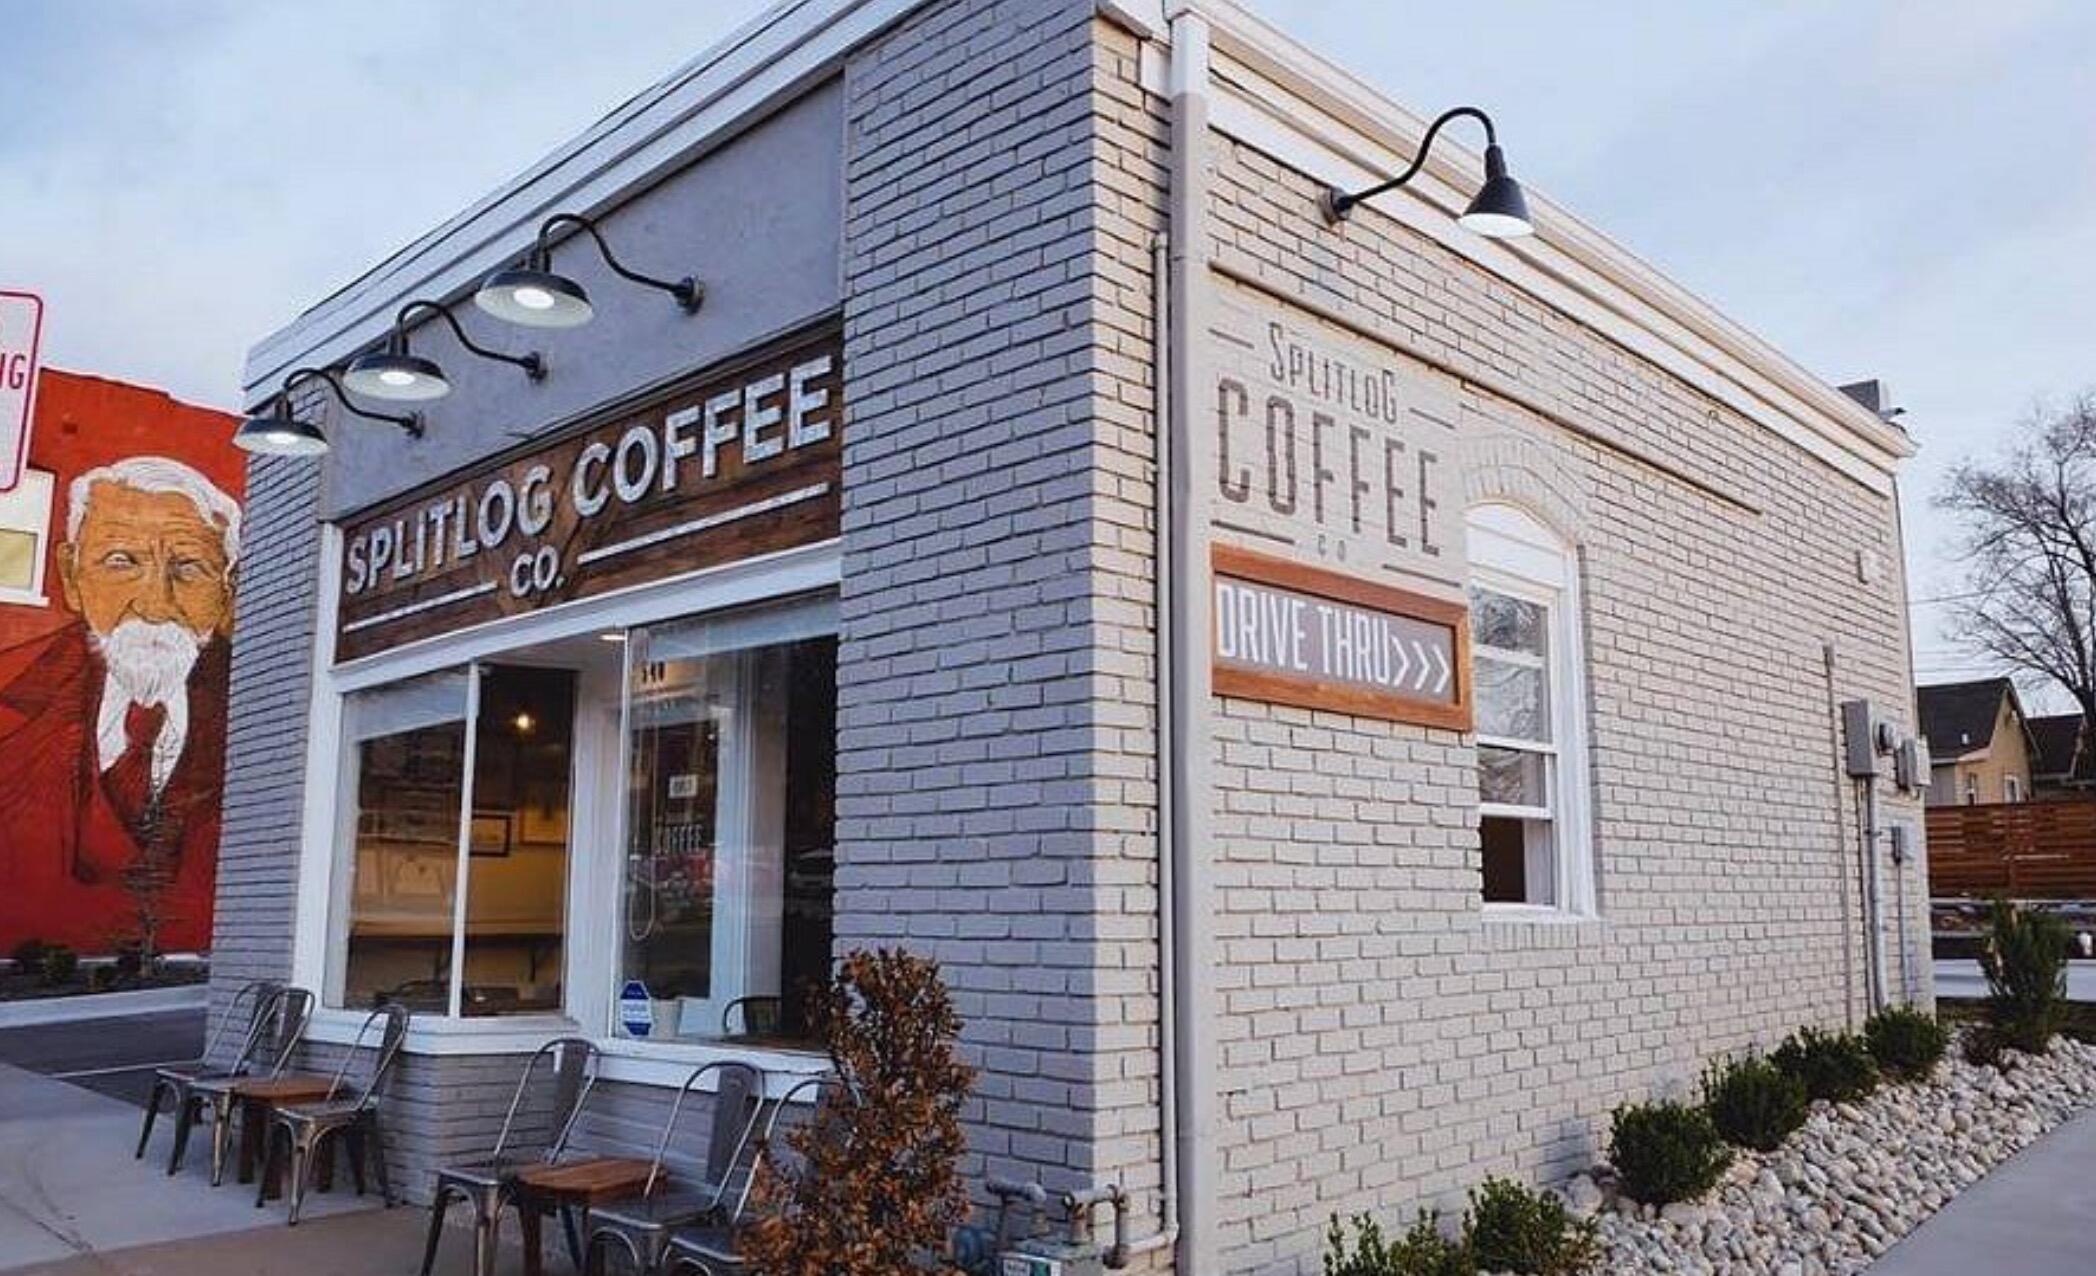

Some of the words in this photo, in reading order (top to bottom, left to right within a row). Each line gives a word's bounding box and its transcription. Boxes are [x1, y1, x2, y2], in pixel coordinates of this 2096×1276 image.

[1268, 322, 1397, 424] SPLITLOG
[346, 464, 554, 595] SPLITLOG
[572, 355, 832, 518] COFFEE
[1218, 378, 1440, 557] COFFEE
[510, 544, 566, 598] CO.
[1216, 583, 1309, 671] DRIVE
[1317, 605, 1390, 685] THRU
